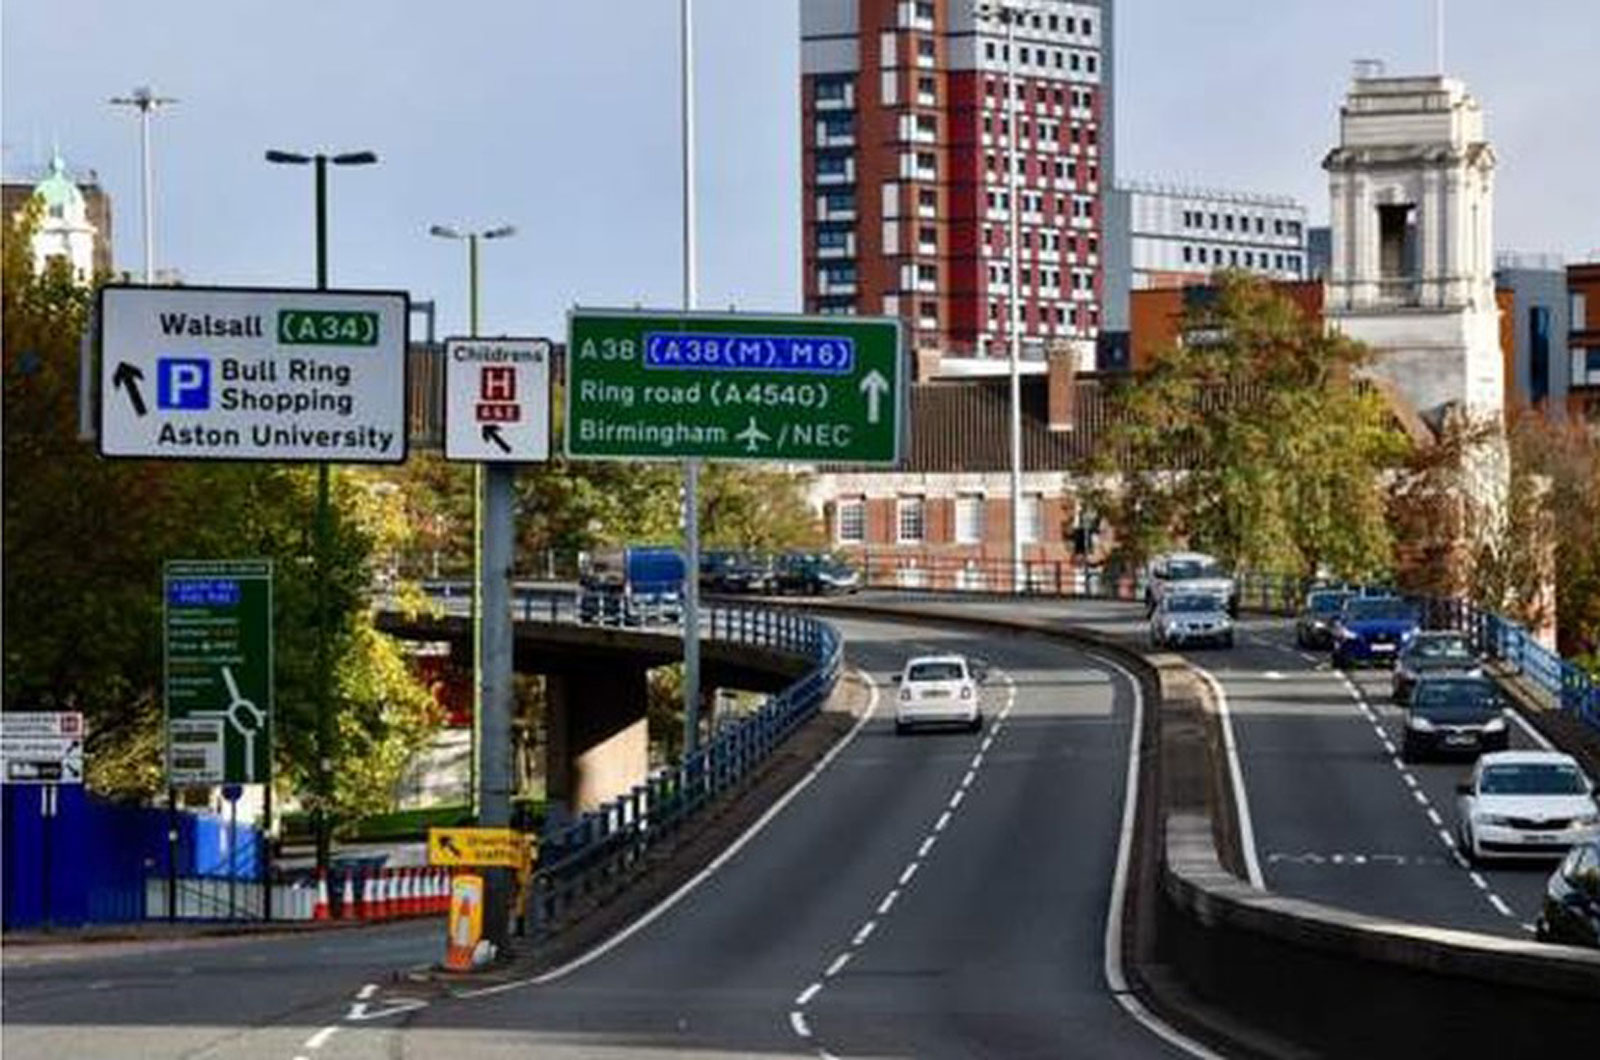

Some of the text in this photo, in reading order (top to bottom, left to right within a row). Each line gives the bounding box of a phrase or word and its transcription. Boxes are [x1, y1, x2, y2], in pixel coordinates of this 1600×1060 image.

[160, 312, 376, 342] Walsall (A34)
[579, 337, 635, 361] A38
[169, 364, 204, 405] P
[221, 359, 351, 387] Bull Ring
[486, 369, 510, 398] H
[220, 388, 353, 415] Shopping
[580, 378, 829, 409] Ring road (A4540)
[157, 423, 394, 452] Aston University
[579, 418, 728, 447] Birmingham
